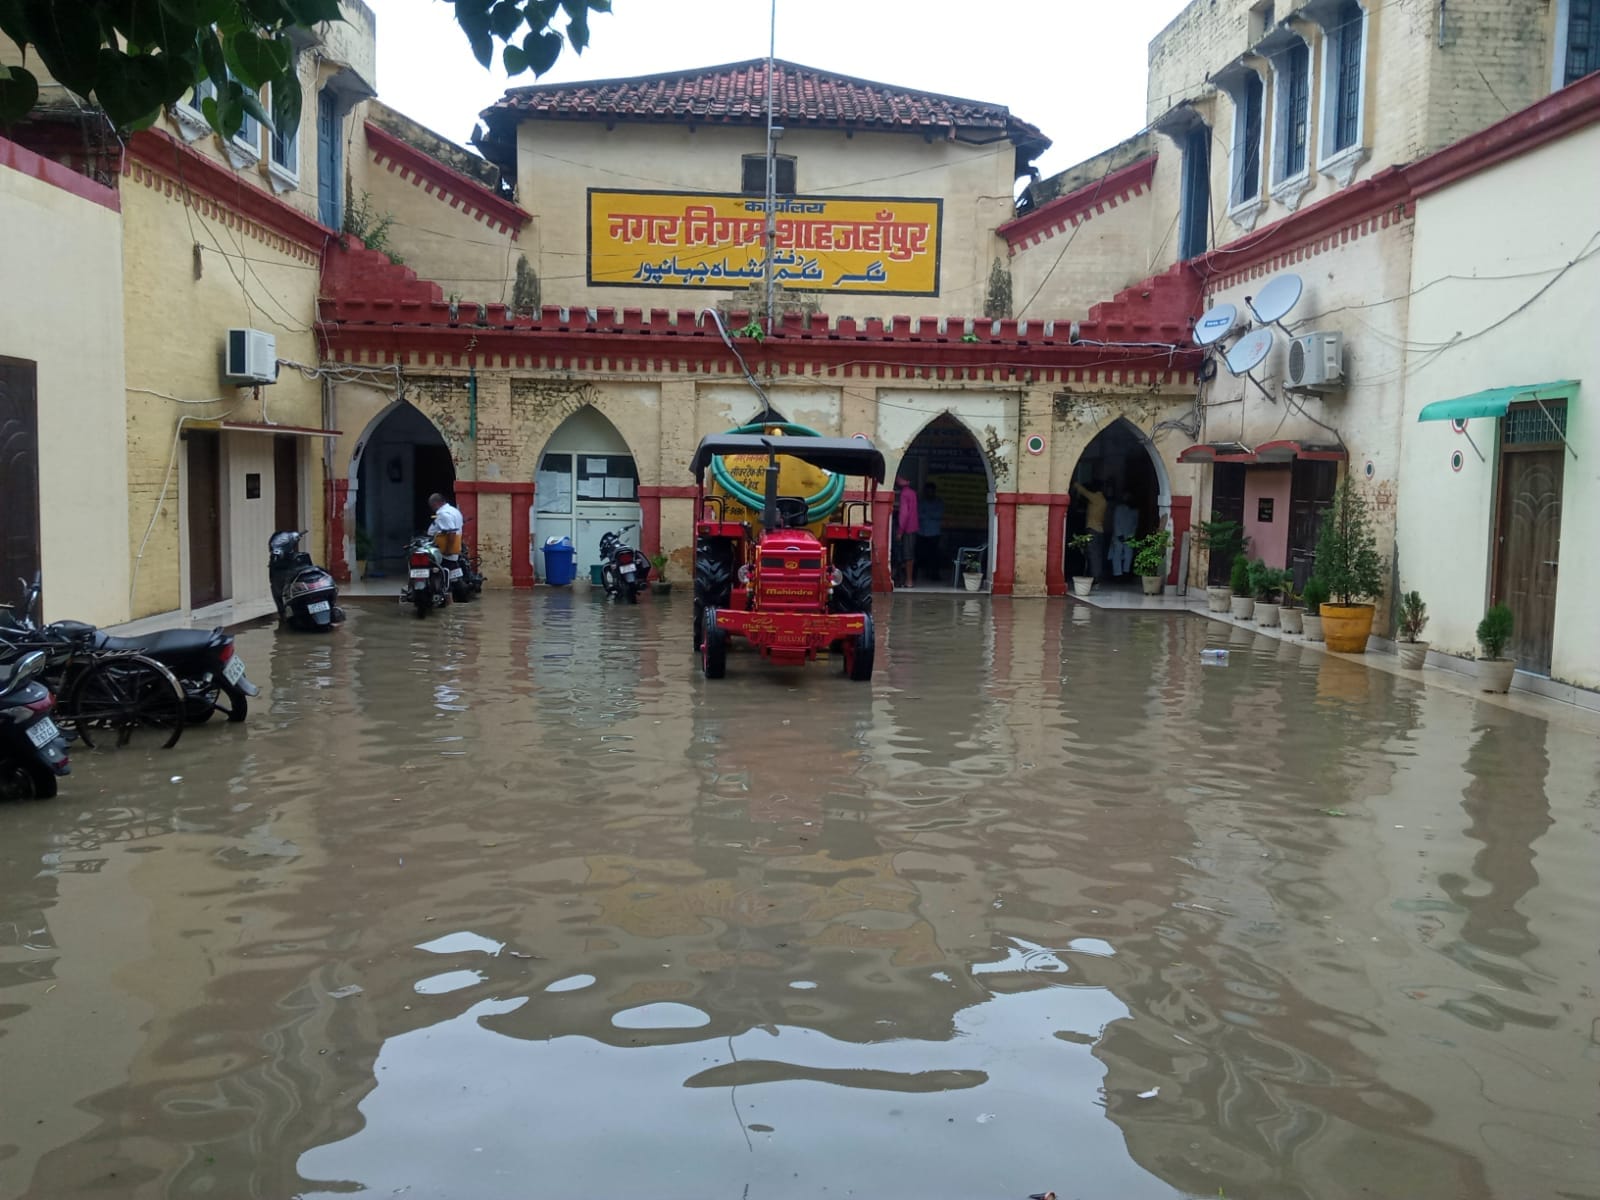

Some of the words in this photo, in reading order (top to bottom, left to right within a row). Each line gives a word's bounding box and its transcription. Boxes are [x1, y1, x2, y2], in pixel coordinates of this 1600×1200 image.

[607, 213, 682, 246] नगर
[682, 205, 767, 249] निगम
[766, 588, 814, 596] Mahindra
